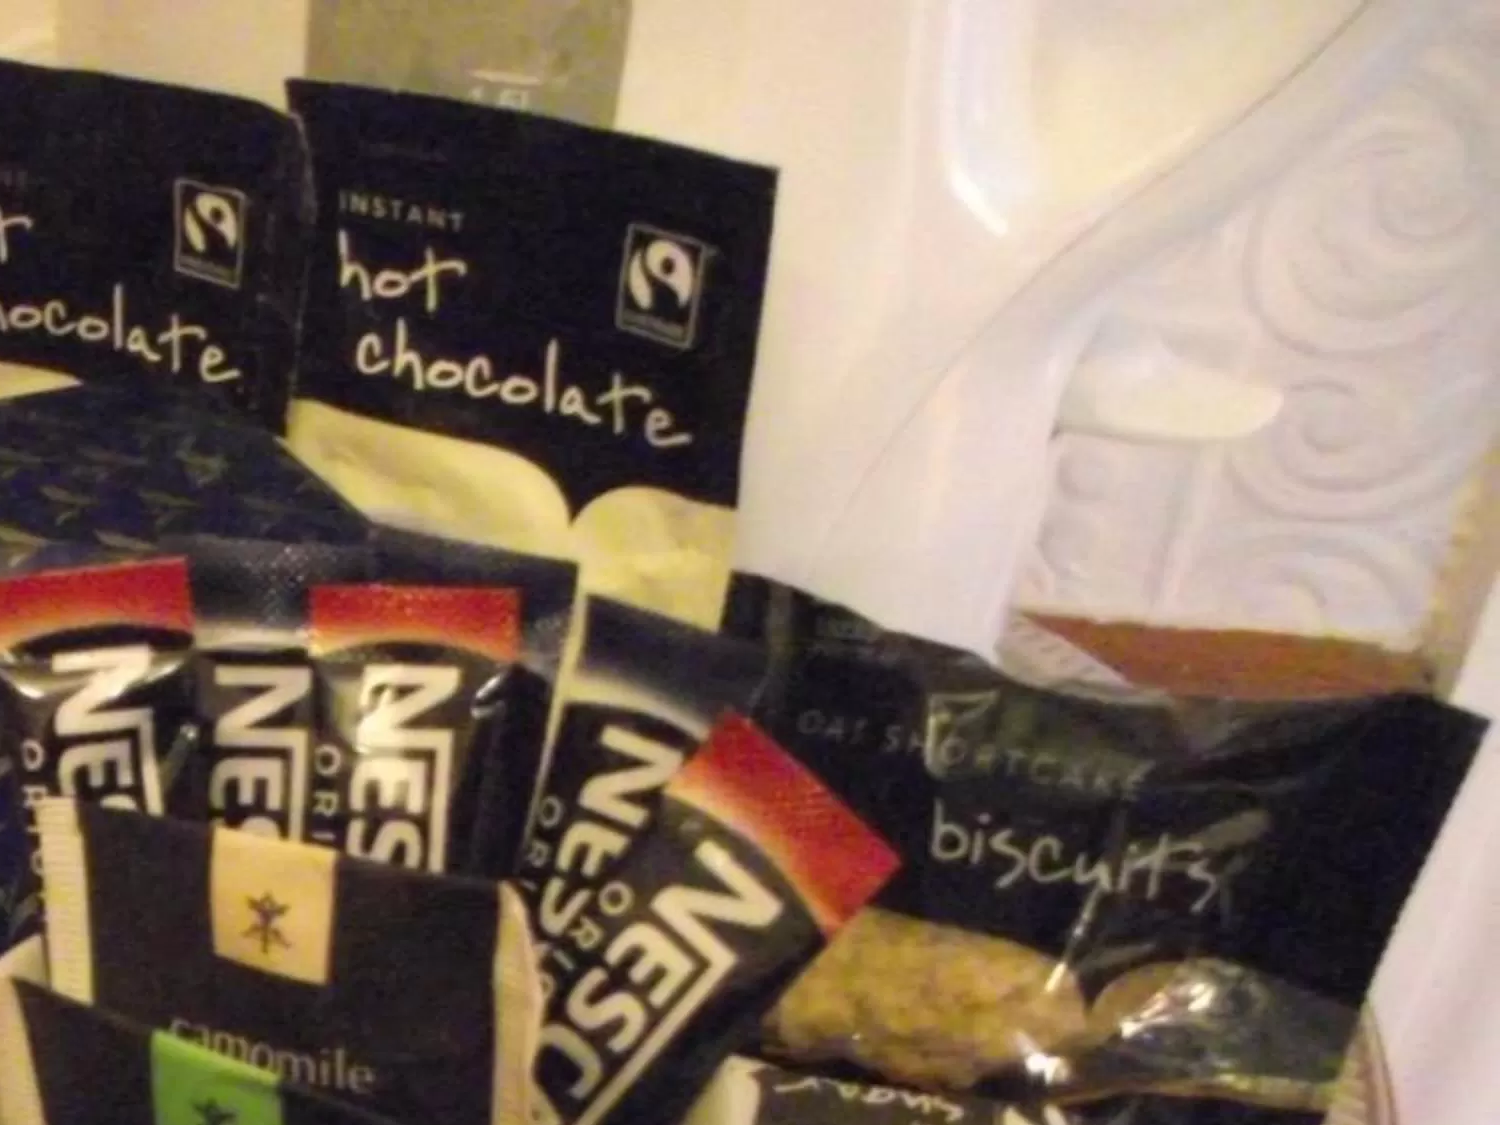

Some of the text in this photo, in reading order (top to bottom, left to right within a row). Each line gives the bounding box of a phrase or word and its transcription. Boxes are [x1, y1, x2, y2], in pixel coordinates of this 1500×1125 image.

[338, 190, 465, 233] INSTANT
[337, 228, 468, 314] hot
[355, 316, 694, 447] chocolate
[930, 797, 1221, 912] biscuits
